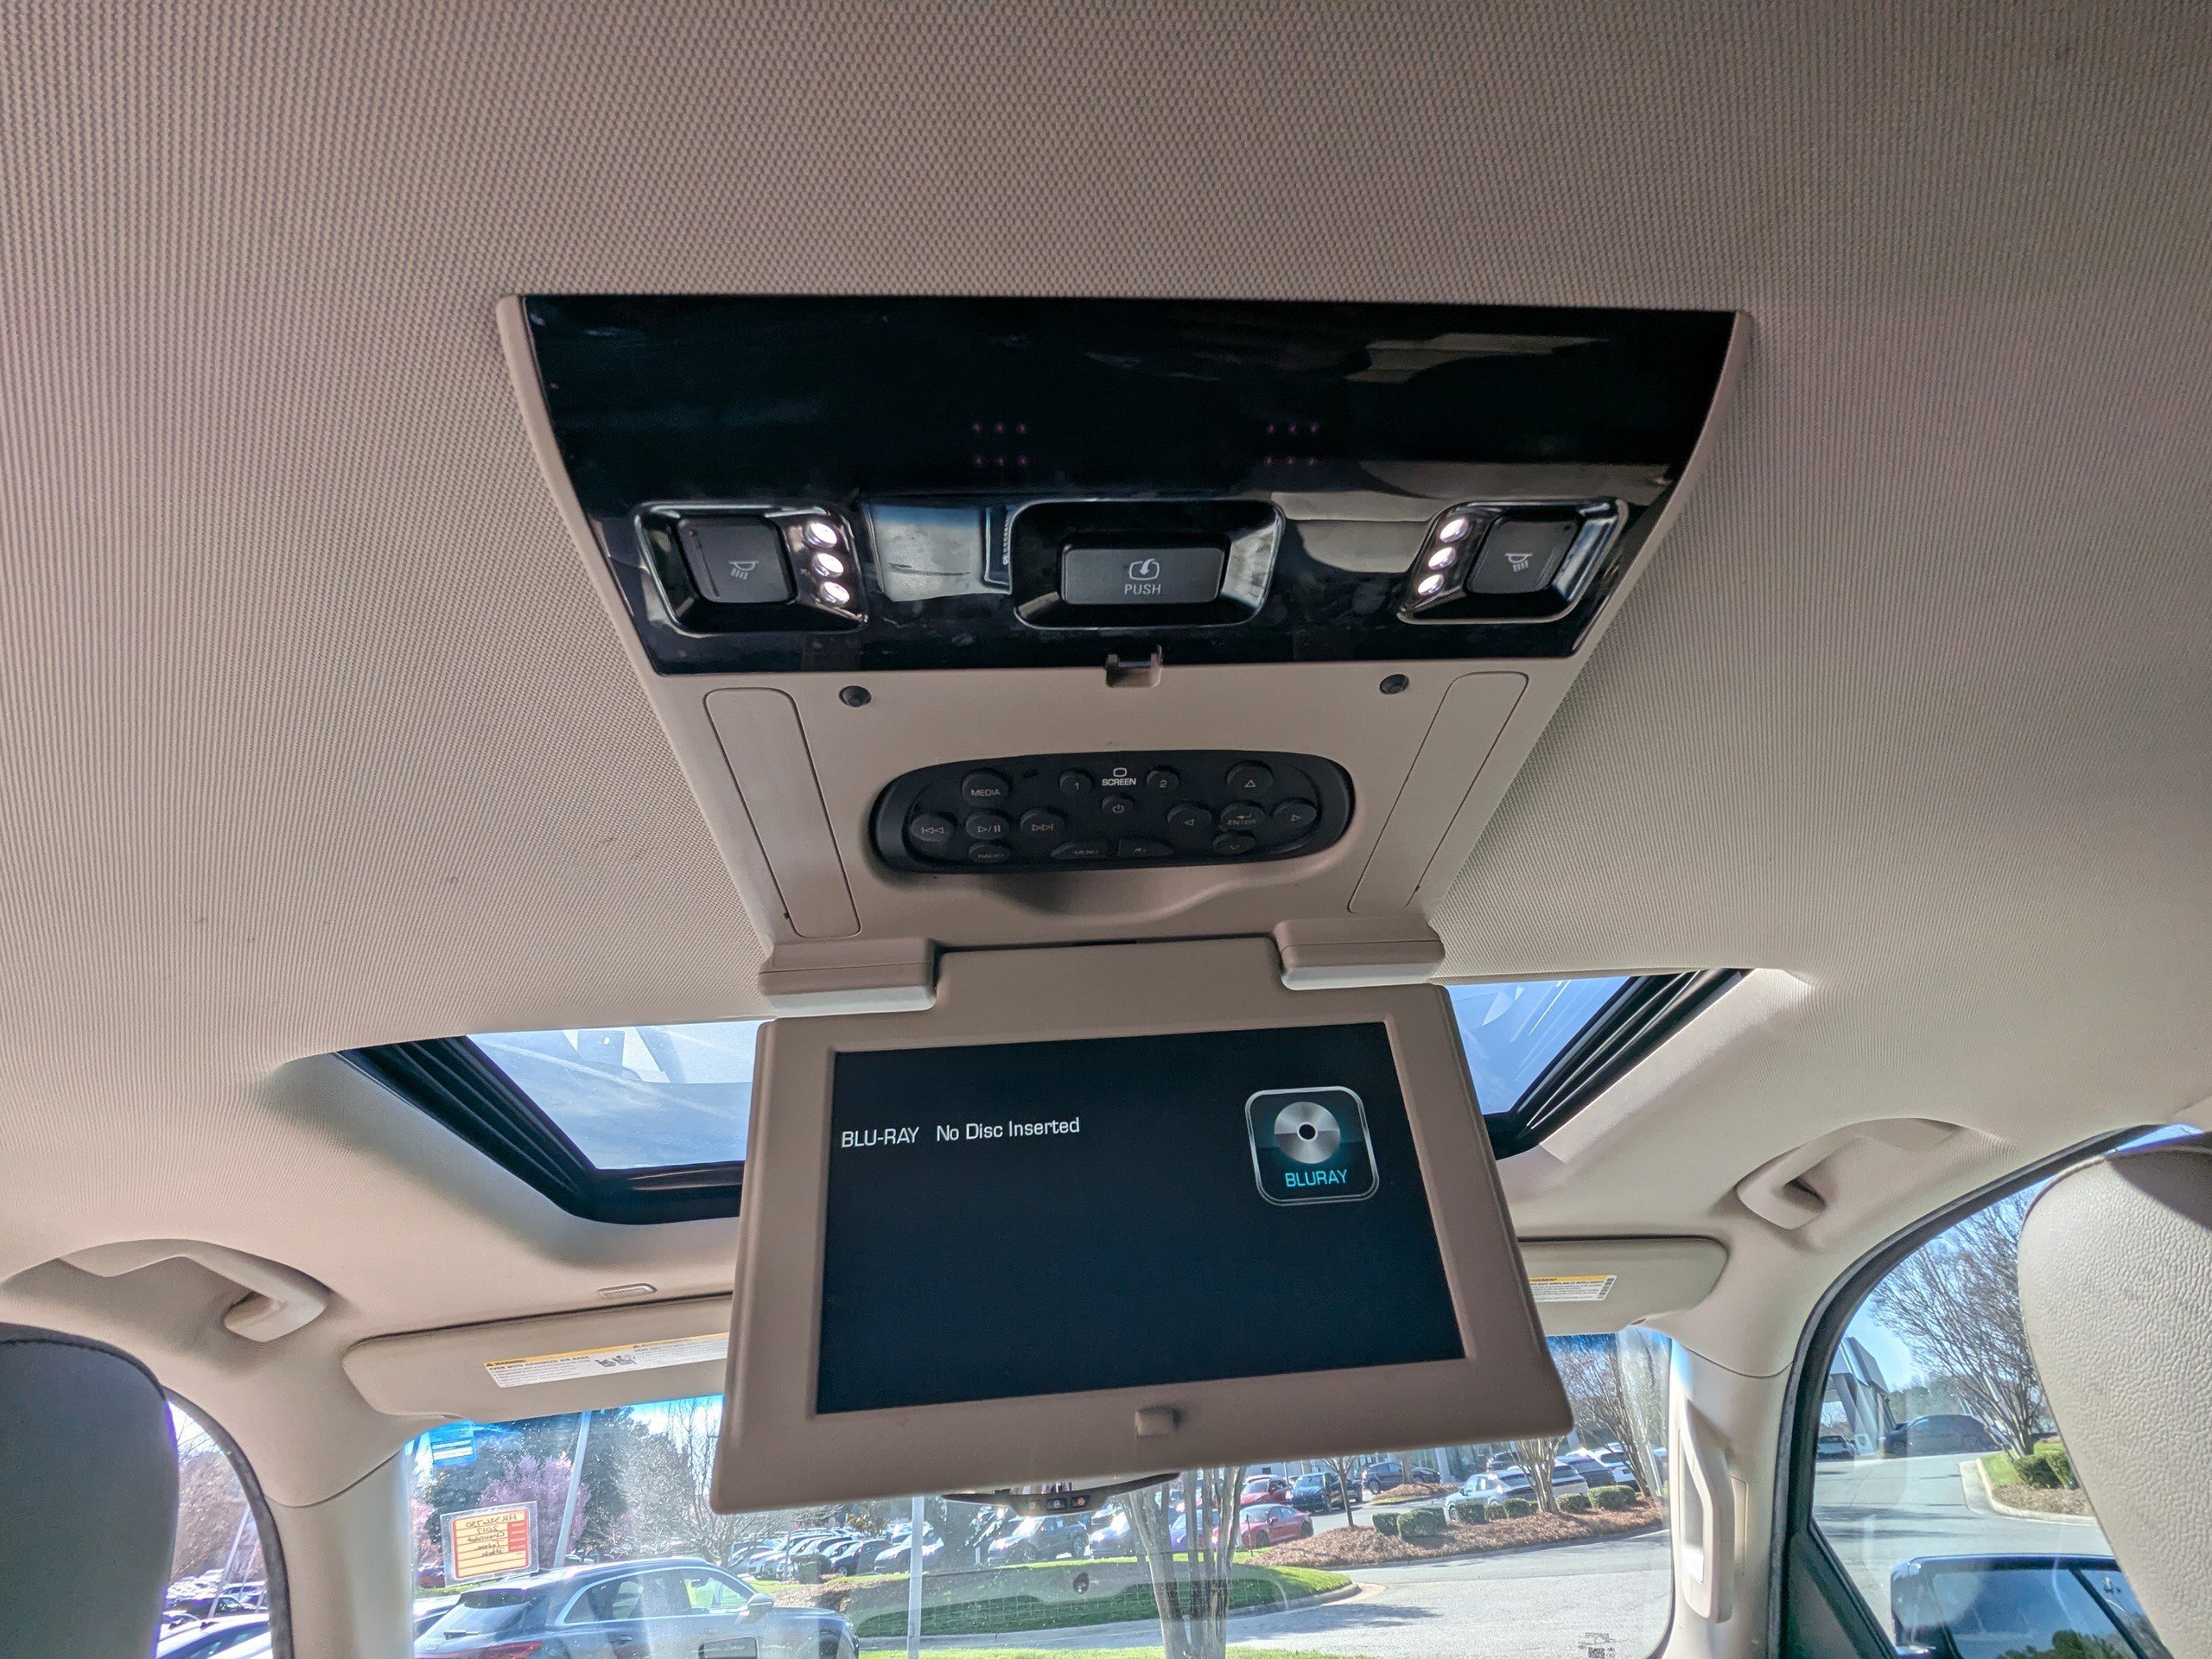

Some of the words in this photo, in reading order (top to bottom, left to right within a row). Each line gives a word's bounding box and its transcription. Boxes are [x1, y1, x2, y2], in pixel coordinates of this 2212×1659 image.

[1124, 583, 1161, 594] PUSH
[1073, 782, 1079, 791] 1
[1102, 778, 1137, 786] SCREEN
[1160, 779, 1167, 788] 2
[842, 1127, 919, 1147] BLU-RAY
[936, 1125, 959, 1142] No
[965, 1122, 1003, 1140] Disc
[1008, 1117, 1080, 1137] Inserted
[1285, 1169, 1347, 1187] BLURAY
